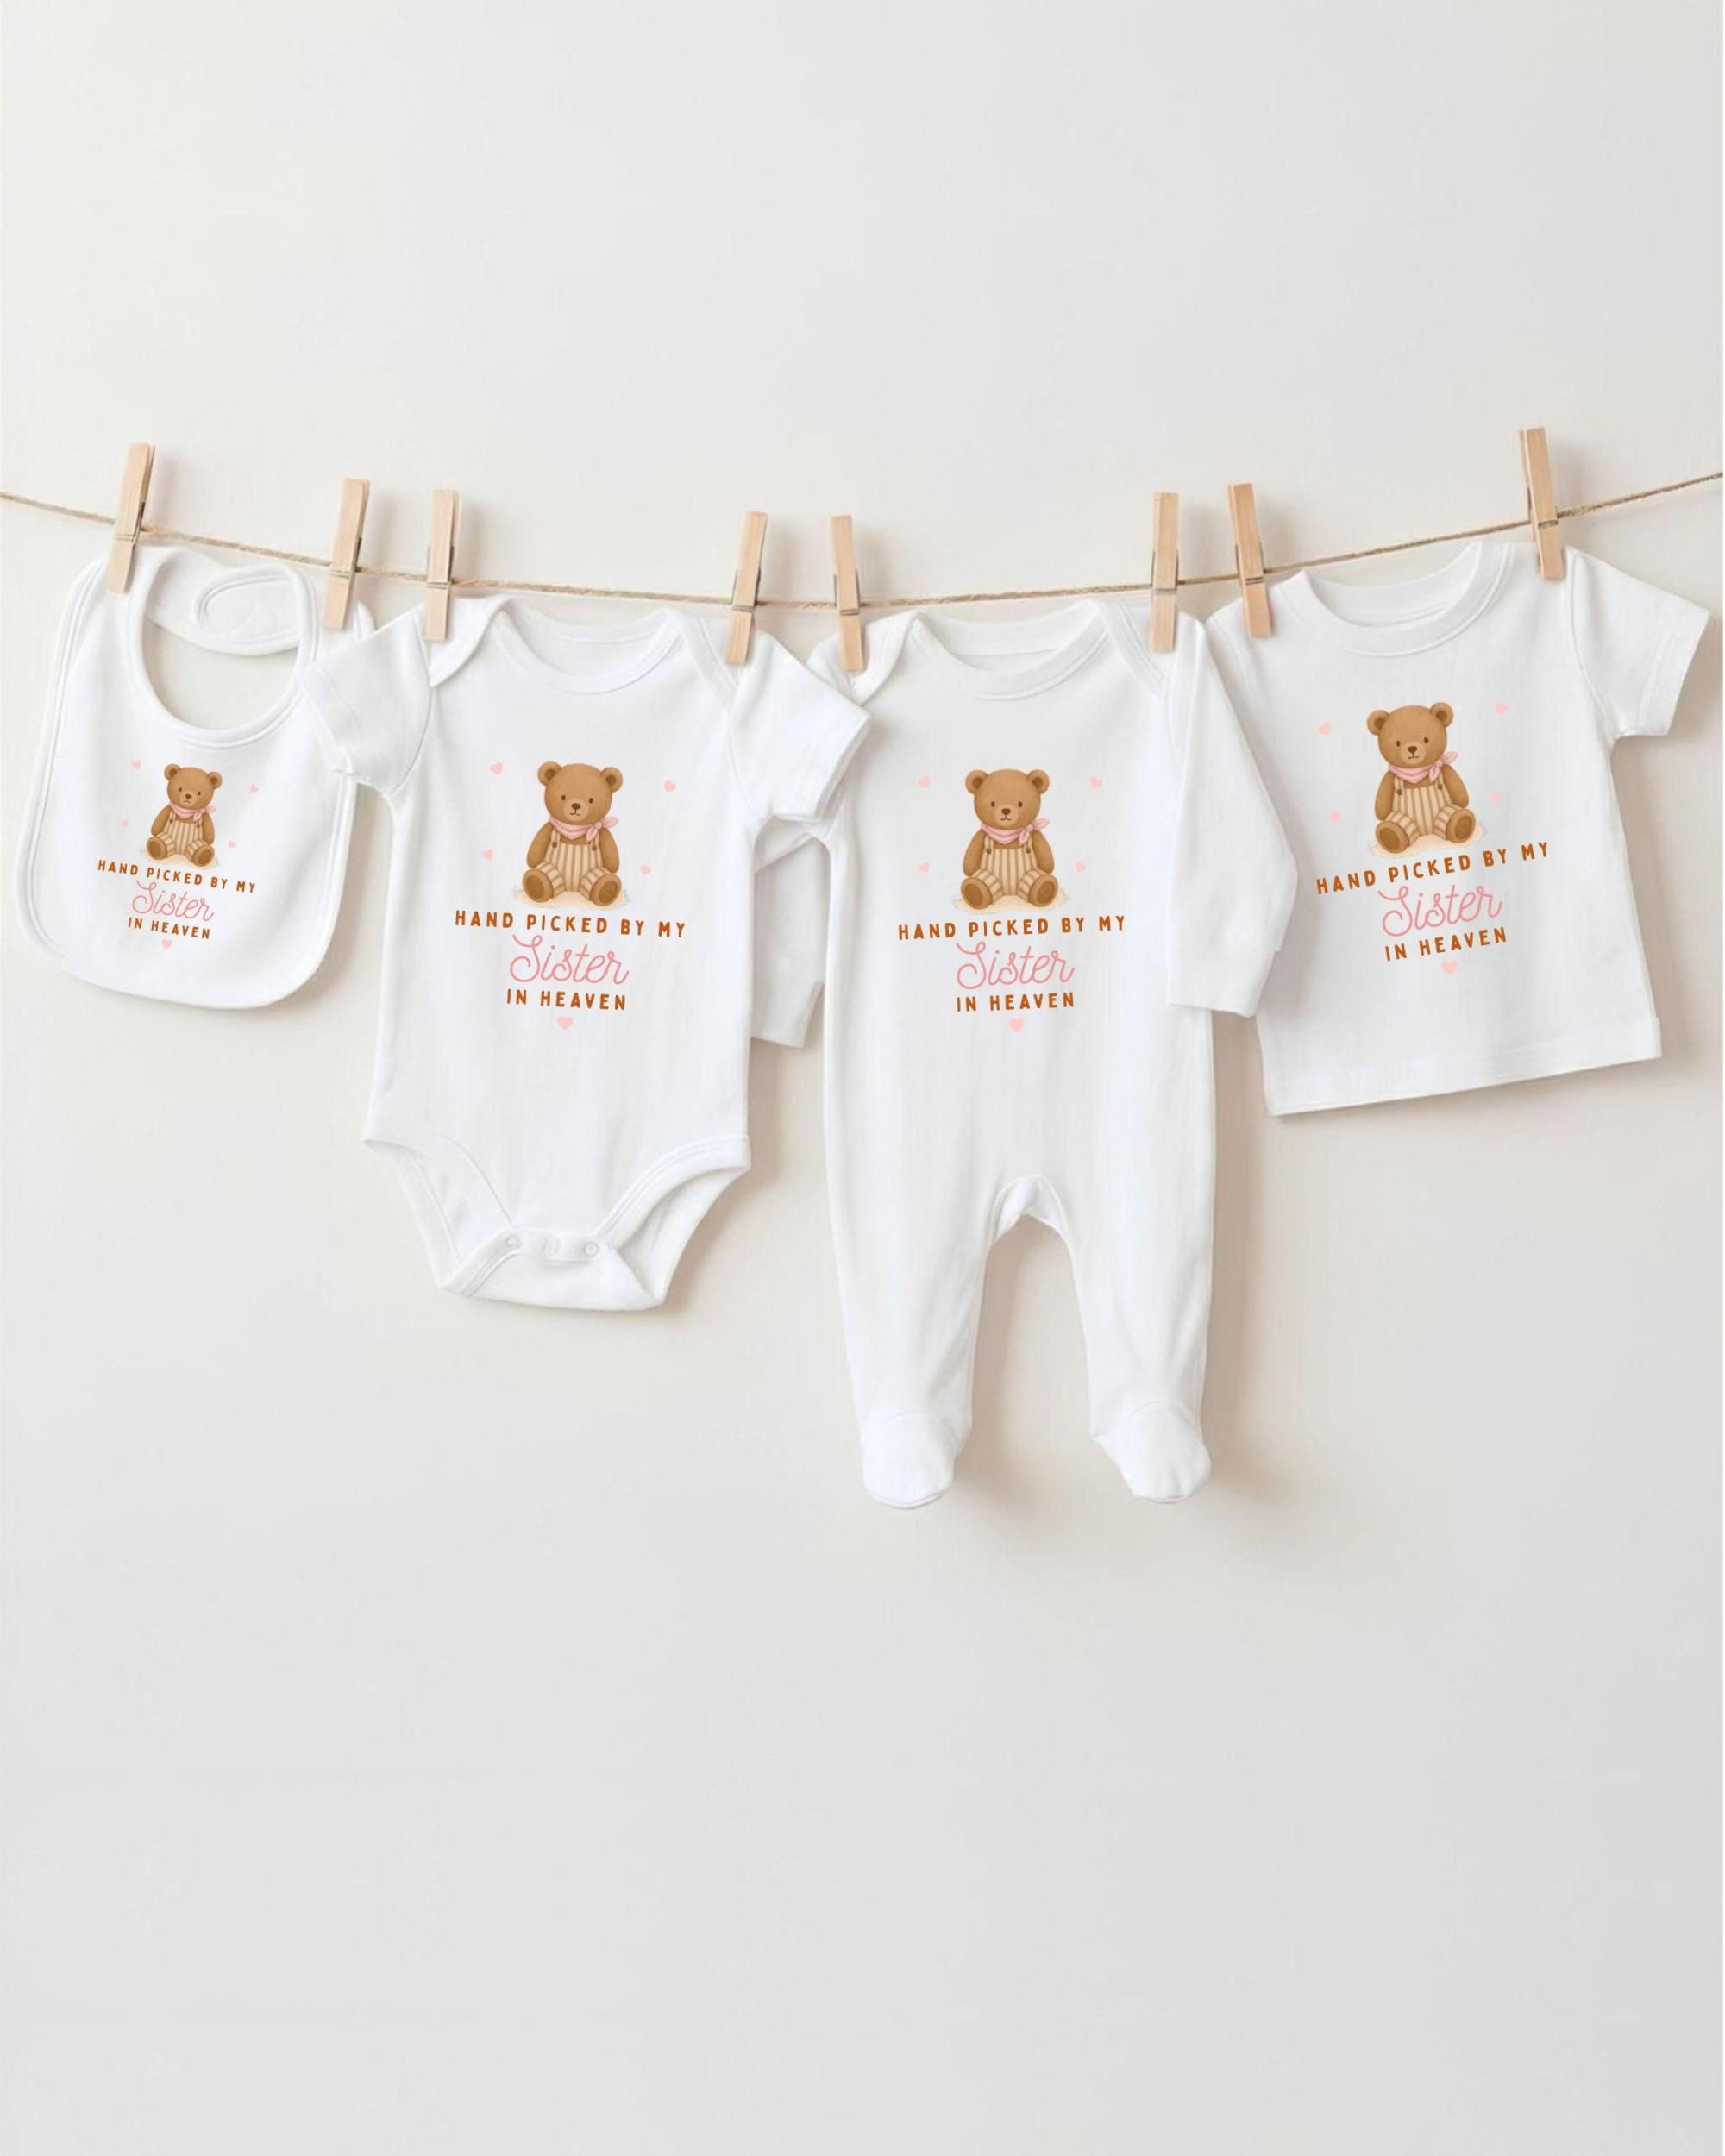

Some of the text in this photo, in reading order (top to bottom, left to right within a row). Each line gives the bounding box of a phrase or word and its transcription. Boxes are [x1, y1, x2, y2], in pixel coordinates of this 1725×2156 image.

[97, 860, 257, 894] HAND PICKED BY MY
[1314, 841, 1549, 896] HAND PICKED BY MY
[132, 880, 215, 921] Sister
[1378, 885, 1503, 937] Sister
[128, 917, 210, 939] IN HEAVEN
[455, 910, 686, 939] HAND PICKED BY MY
[897, 914, 1126, 940] HAND PICKED BY MY
[509, 934, 630, 985] Sister
[1383, 926, 1509, 962] IN HEAVEN
[956, 941, 1075, 989] Sister
[505, 987, 626, 1012] IN HEAVEN
[956, 992, 1075, 1013] IN HEAVEN
